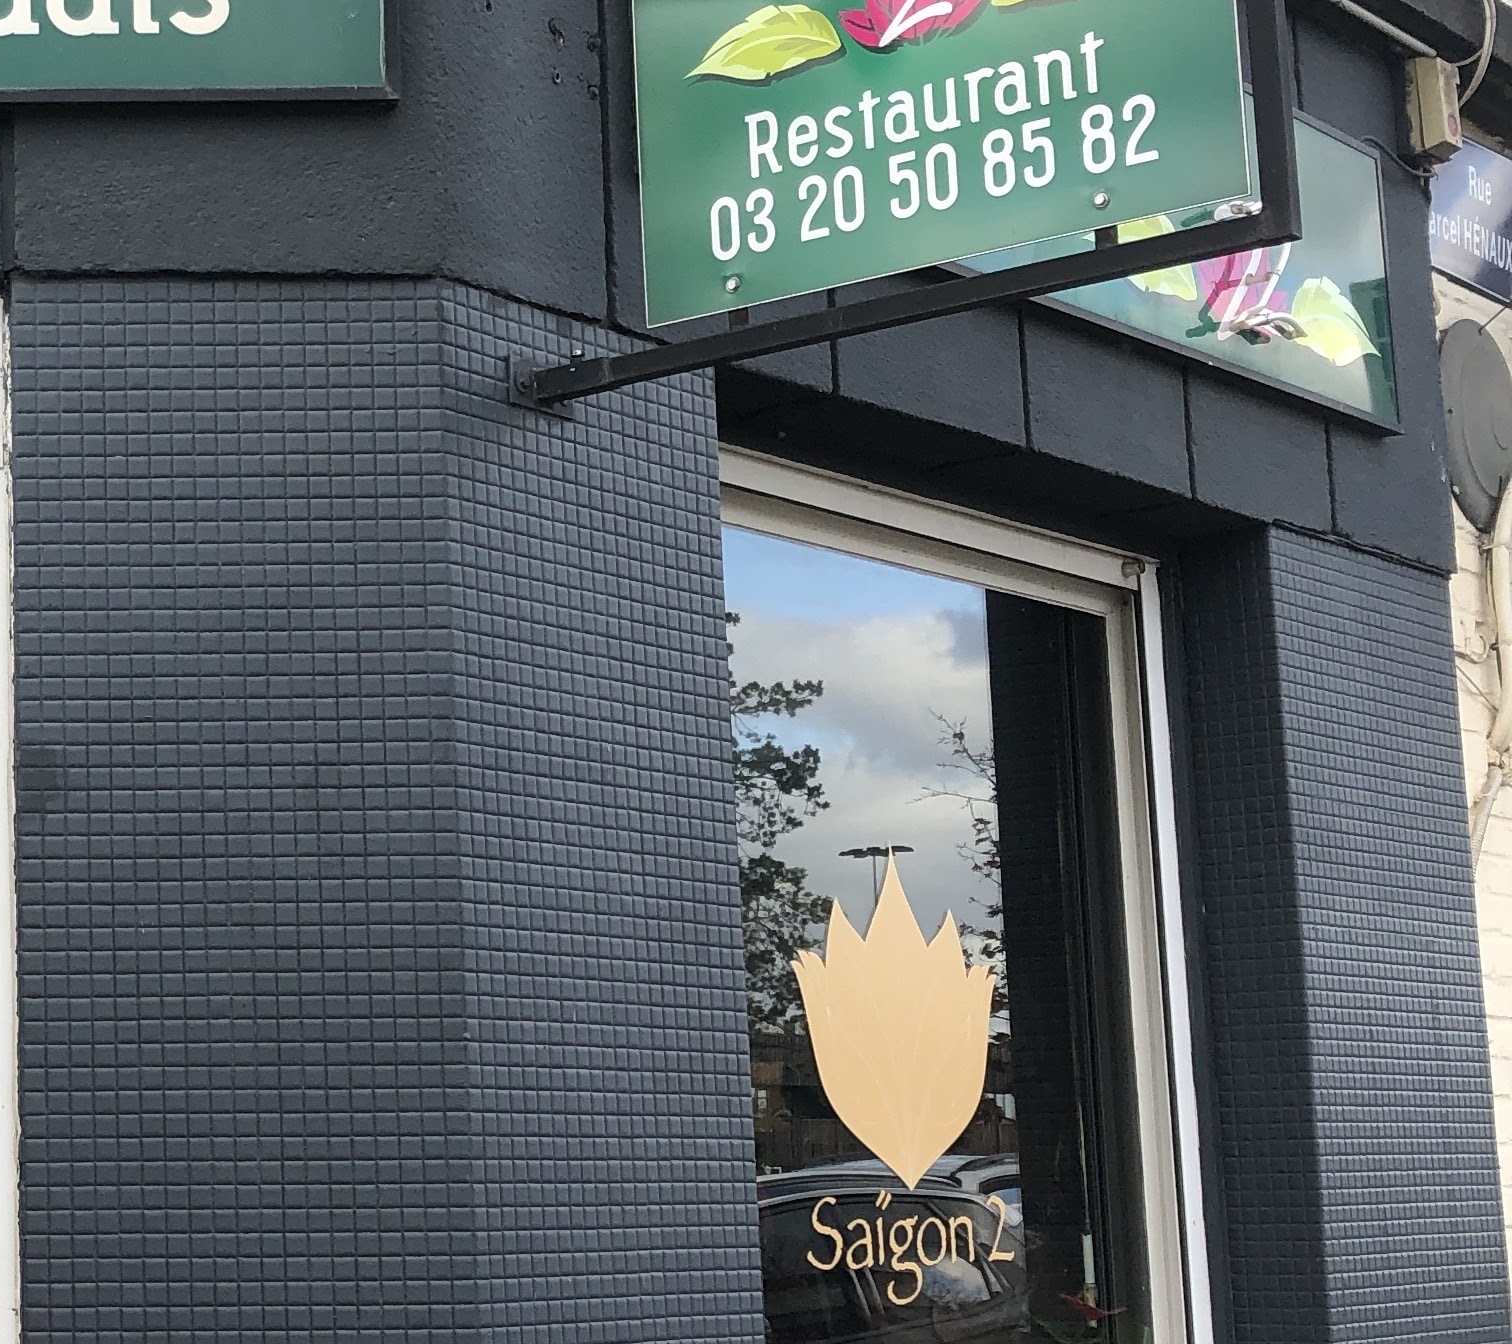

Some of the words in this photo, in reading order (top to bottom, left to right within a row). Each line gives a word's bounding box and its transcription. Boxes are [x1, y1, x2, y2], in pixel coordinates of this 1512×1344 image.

[744, 30, 1105, 179] Restaurant
[710, 187, 776, 262] 03
[798, 164, 866, 243] 20
[888, 142, 959, 220] 50
[982, 116, 1056, 198] 85
[1080, 93, 1160, 175] 82
[1467, 165, 1493, 206] Rue
[806, 1189, 976, 1306] Saïgon
[986, 1195, 1016, 1263] 2
